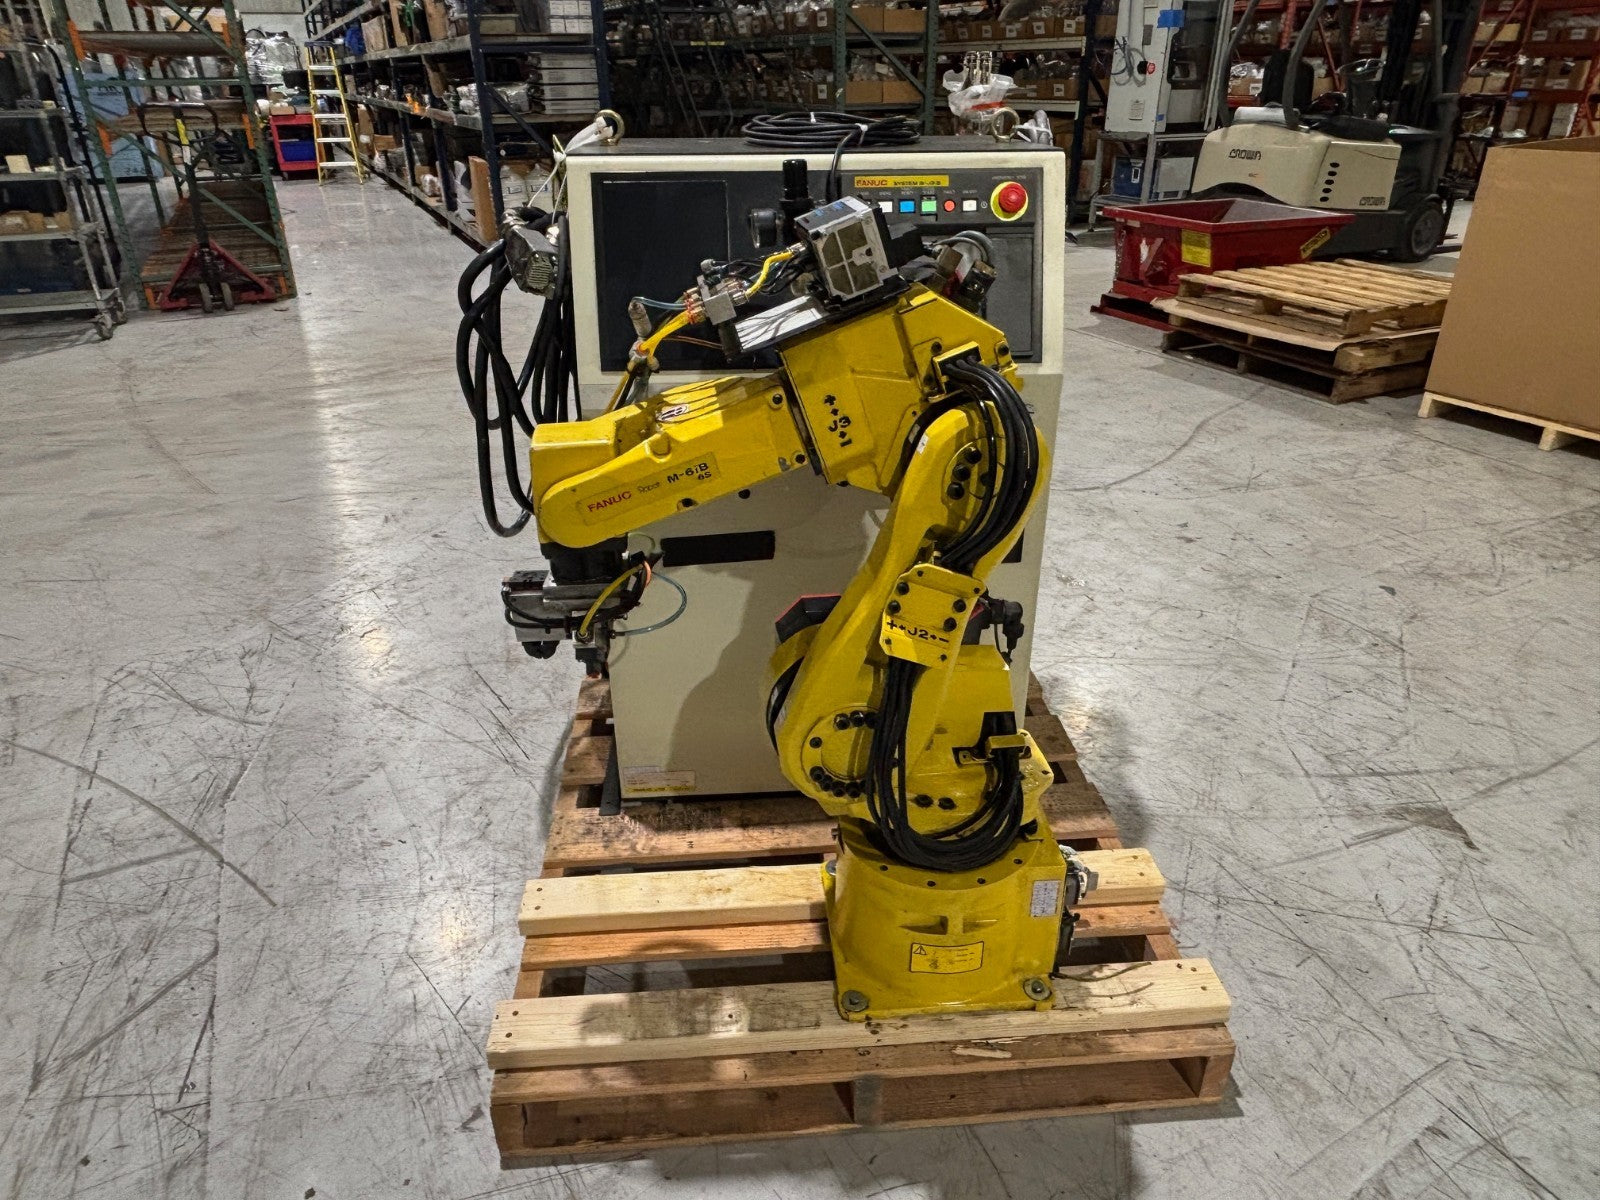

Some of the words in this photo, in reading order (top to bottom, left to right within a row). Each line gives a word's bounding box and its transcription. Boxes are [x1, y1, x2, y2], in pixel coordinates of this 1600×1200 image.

[1228, 148, 1262, 160] CROWN
[856, 179, 888, 187] FANUC
[587, 490, 632, 513] FANUC
